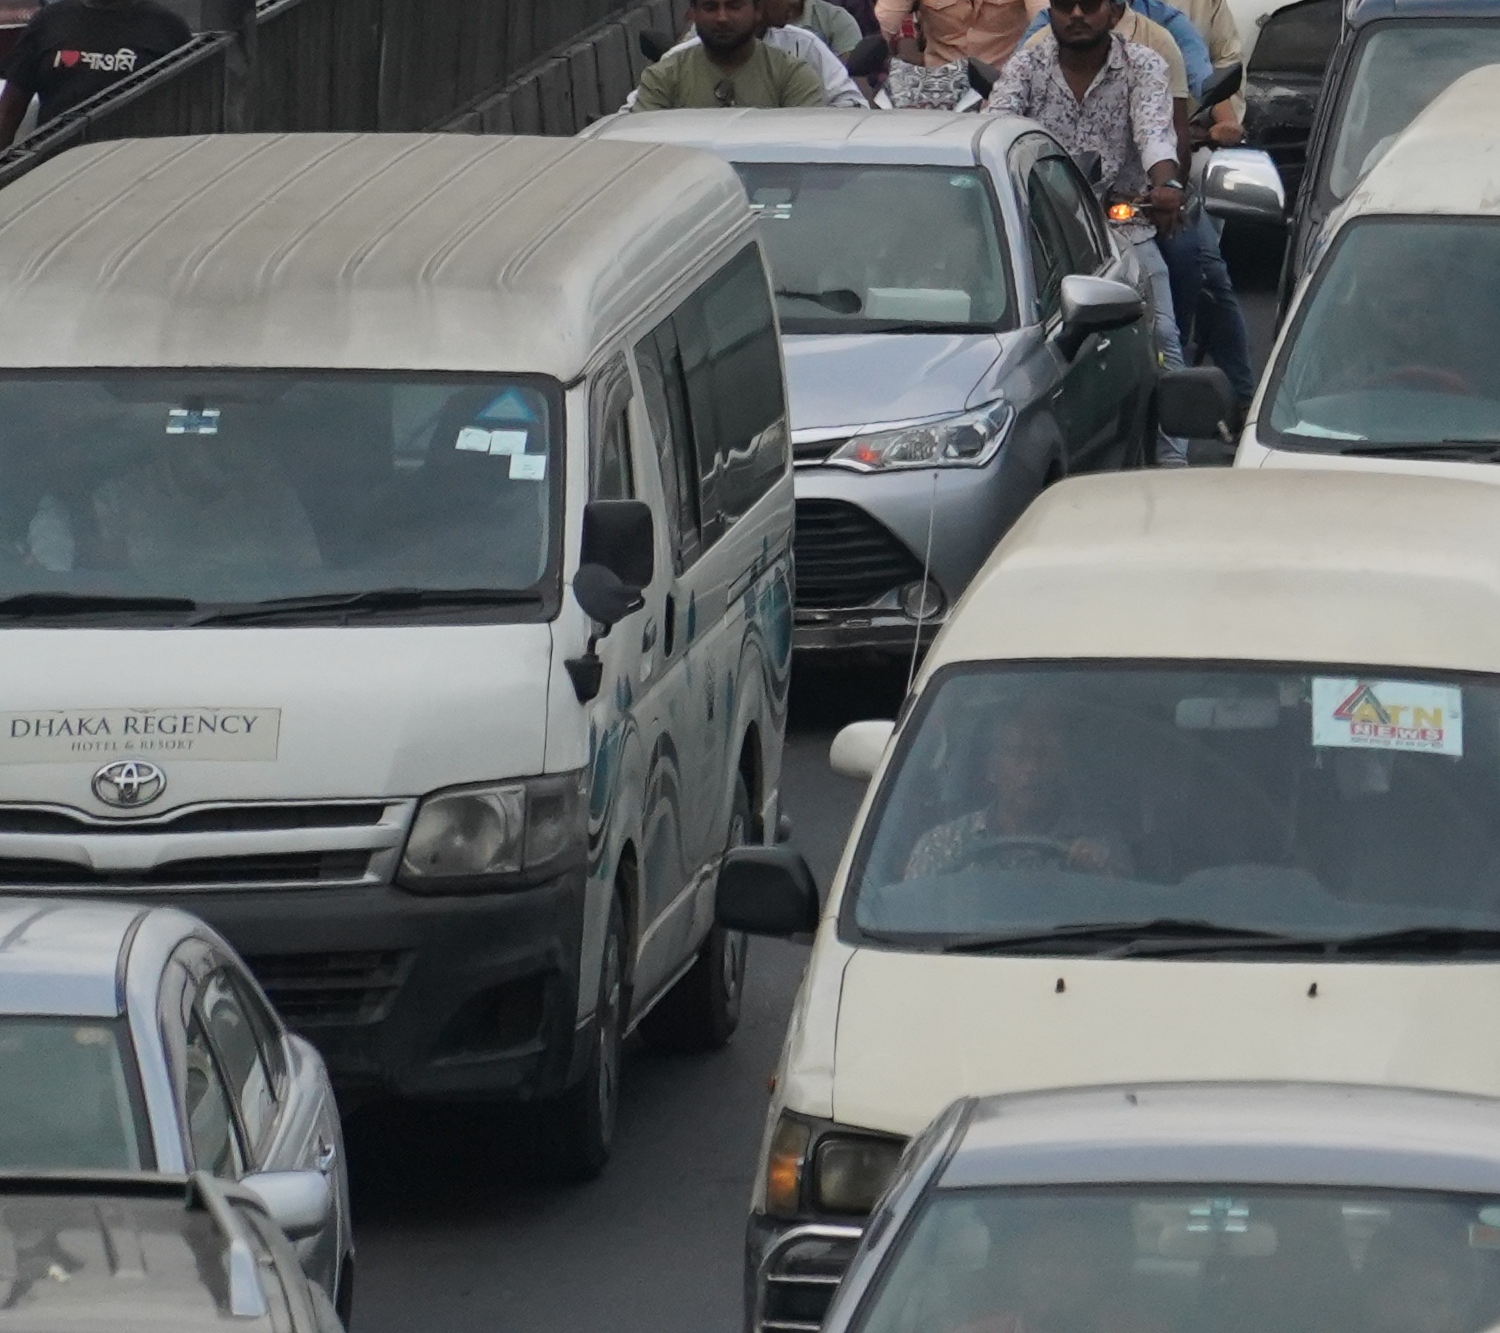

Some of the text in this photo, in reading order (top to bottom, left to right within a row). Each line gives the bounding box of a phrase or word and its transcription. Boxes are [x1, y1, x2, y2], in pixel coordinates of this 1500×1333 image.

[10, 714, 260, 738] DHAKA REGENCY
[1352, 724, 1443, 741] NEWS
[71, 739, 118, 752] HOTEL
[140, 738, 195, 751] RESORT
